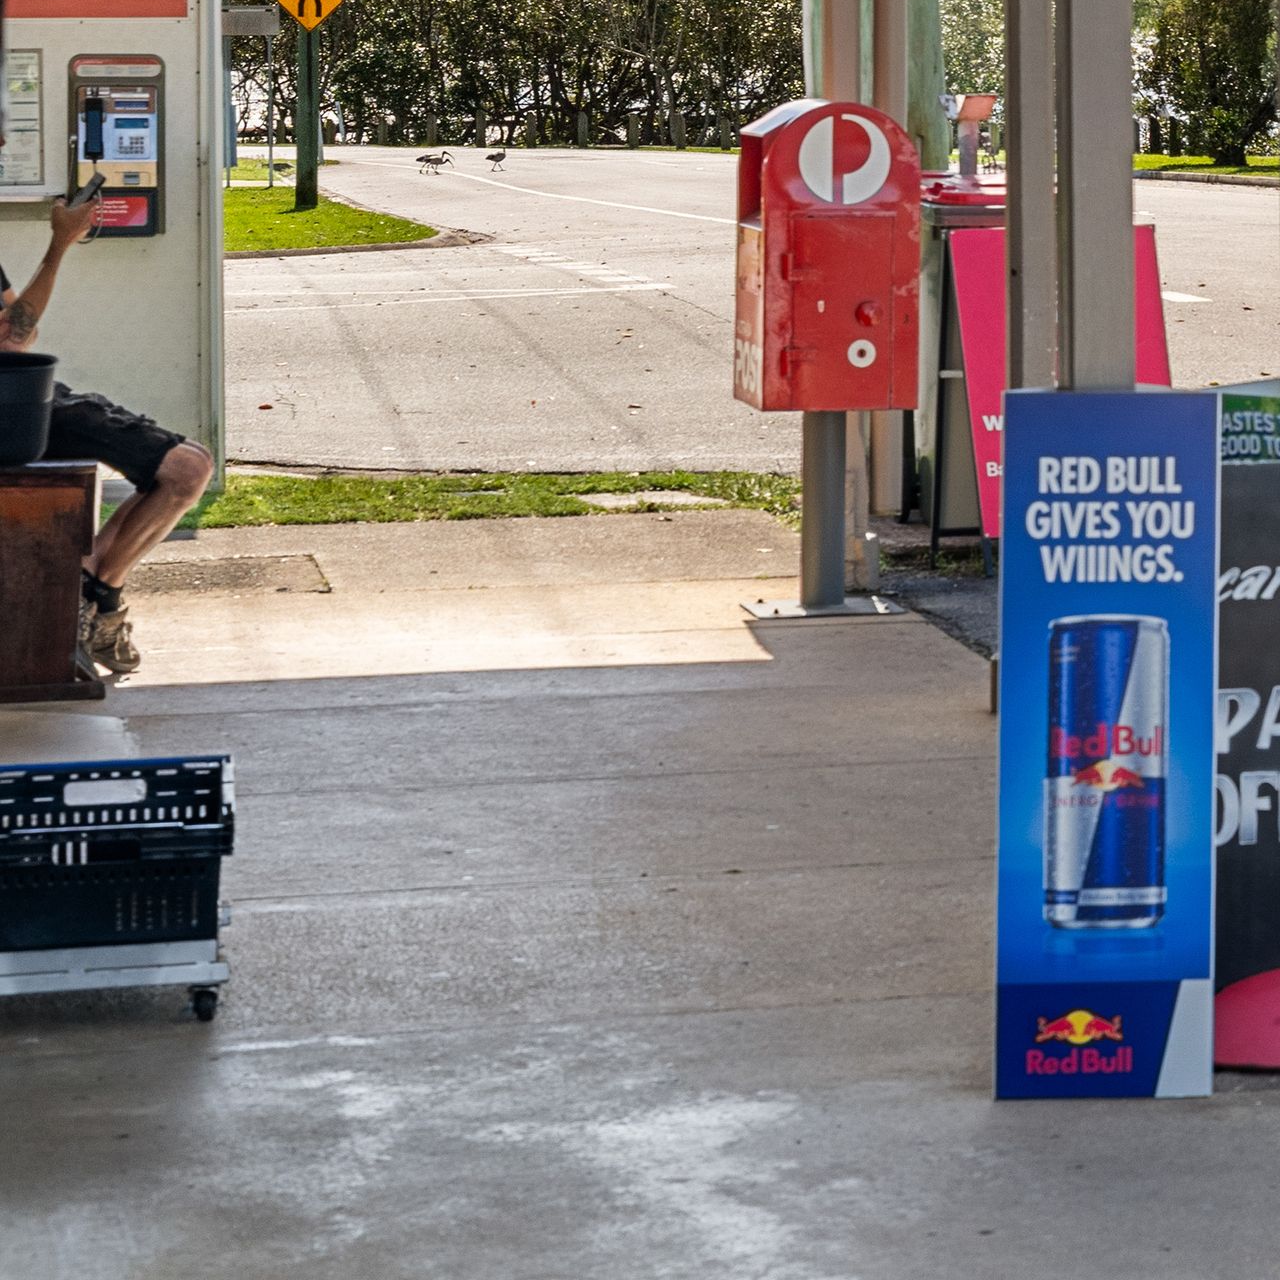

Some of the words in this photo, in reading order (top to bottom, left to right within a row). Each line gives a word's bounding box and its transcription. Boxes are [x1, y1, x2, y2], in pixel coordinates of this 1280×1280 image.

[1222, 410, 1276, 433] ASTES
[1038, 456, 1101, 494] RED
[1106, 456, 1182, 494] BULL
[1025, 500, 1121, 539] GIVES
[1125, 500, 1195, 539] YOU
[1039, 544, 1185, 583] WIIINGS.
[1026, 1047, 1079, 1075] Red
[1081, 1046, 1133, 1074] Bull
